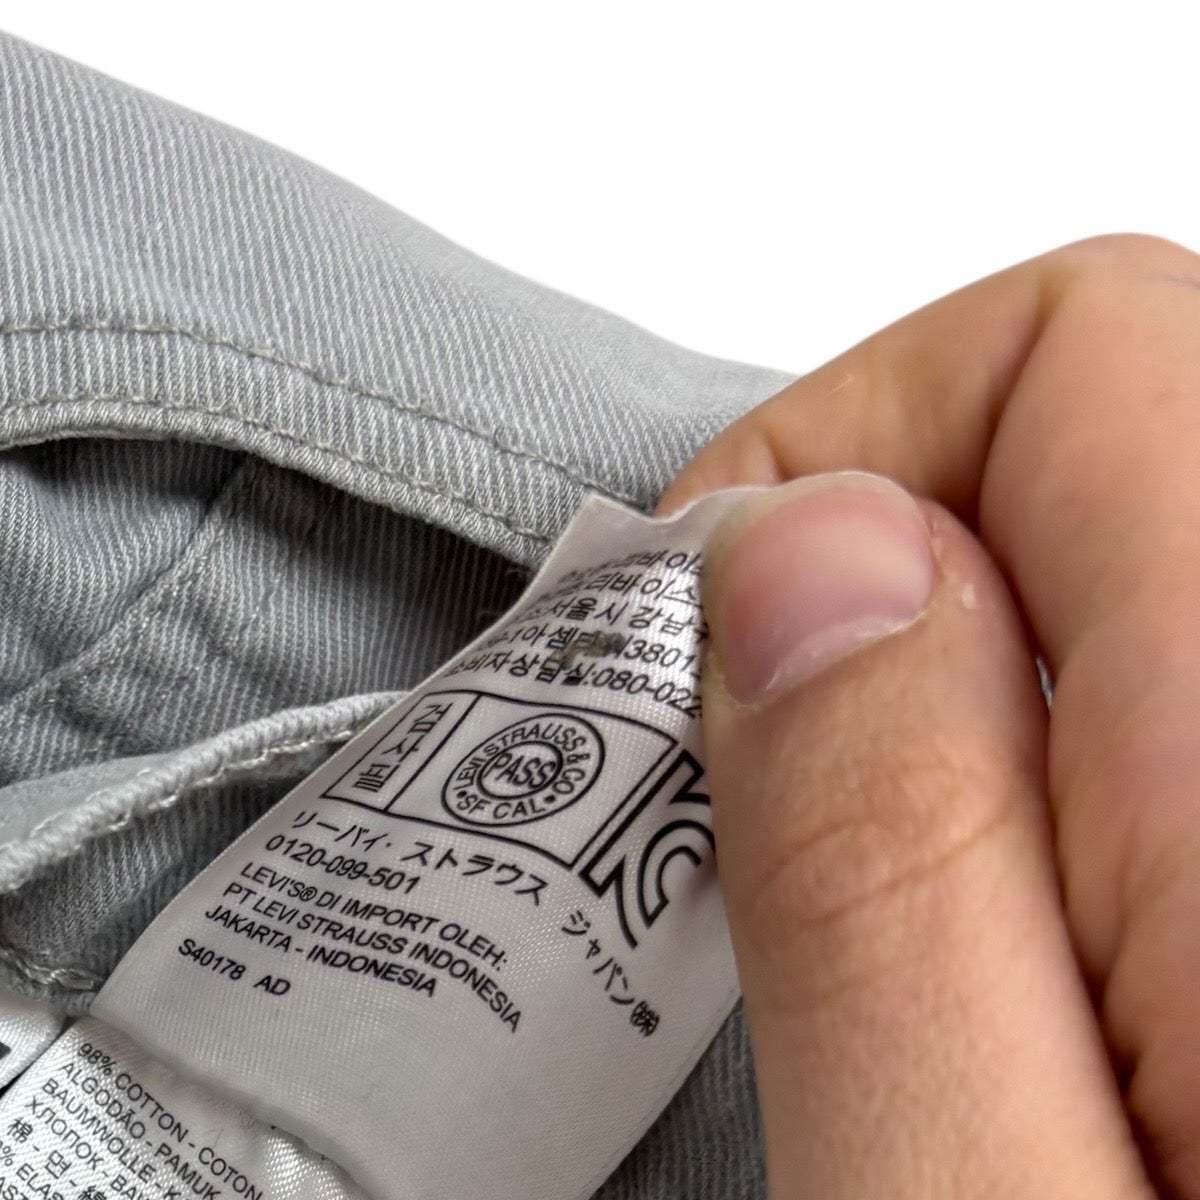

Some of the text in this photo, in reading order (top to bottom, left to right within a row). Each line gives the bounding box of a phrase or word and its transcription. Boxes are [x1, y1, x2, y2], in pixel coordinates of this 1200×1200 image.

[452, 757, 486, 791] LEVI
[483, 722, 587, 756] STRAUSS
[482, 750, 557, 790] PASS
[456, 792, 546, 820] SF CAL
[265, 834, 422, 895] 0120-099-501
[178, 937, 292, 998] S40178 AD
[205, 904, 439, 998] JAKARTA INDONESIA
[223, 881, 523, 1034] PT LEVI STRAUSS INDONESIA
[317, 890, 342, 910] DI
[341, 897, 440, 935] IMPORT
[439, 922, 509, 972] OLEH:
[59, 1061, 146, 1140] ALGODÃO
[77, 1042, 117, 1076] 98%
[115, 1072, 189, 1143] COTTON
[42, 1078, 156, 1185] BAUMWOLLE
[46, 1150, 72, 1179] 면
